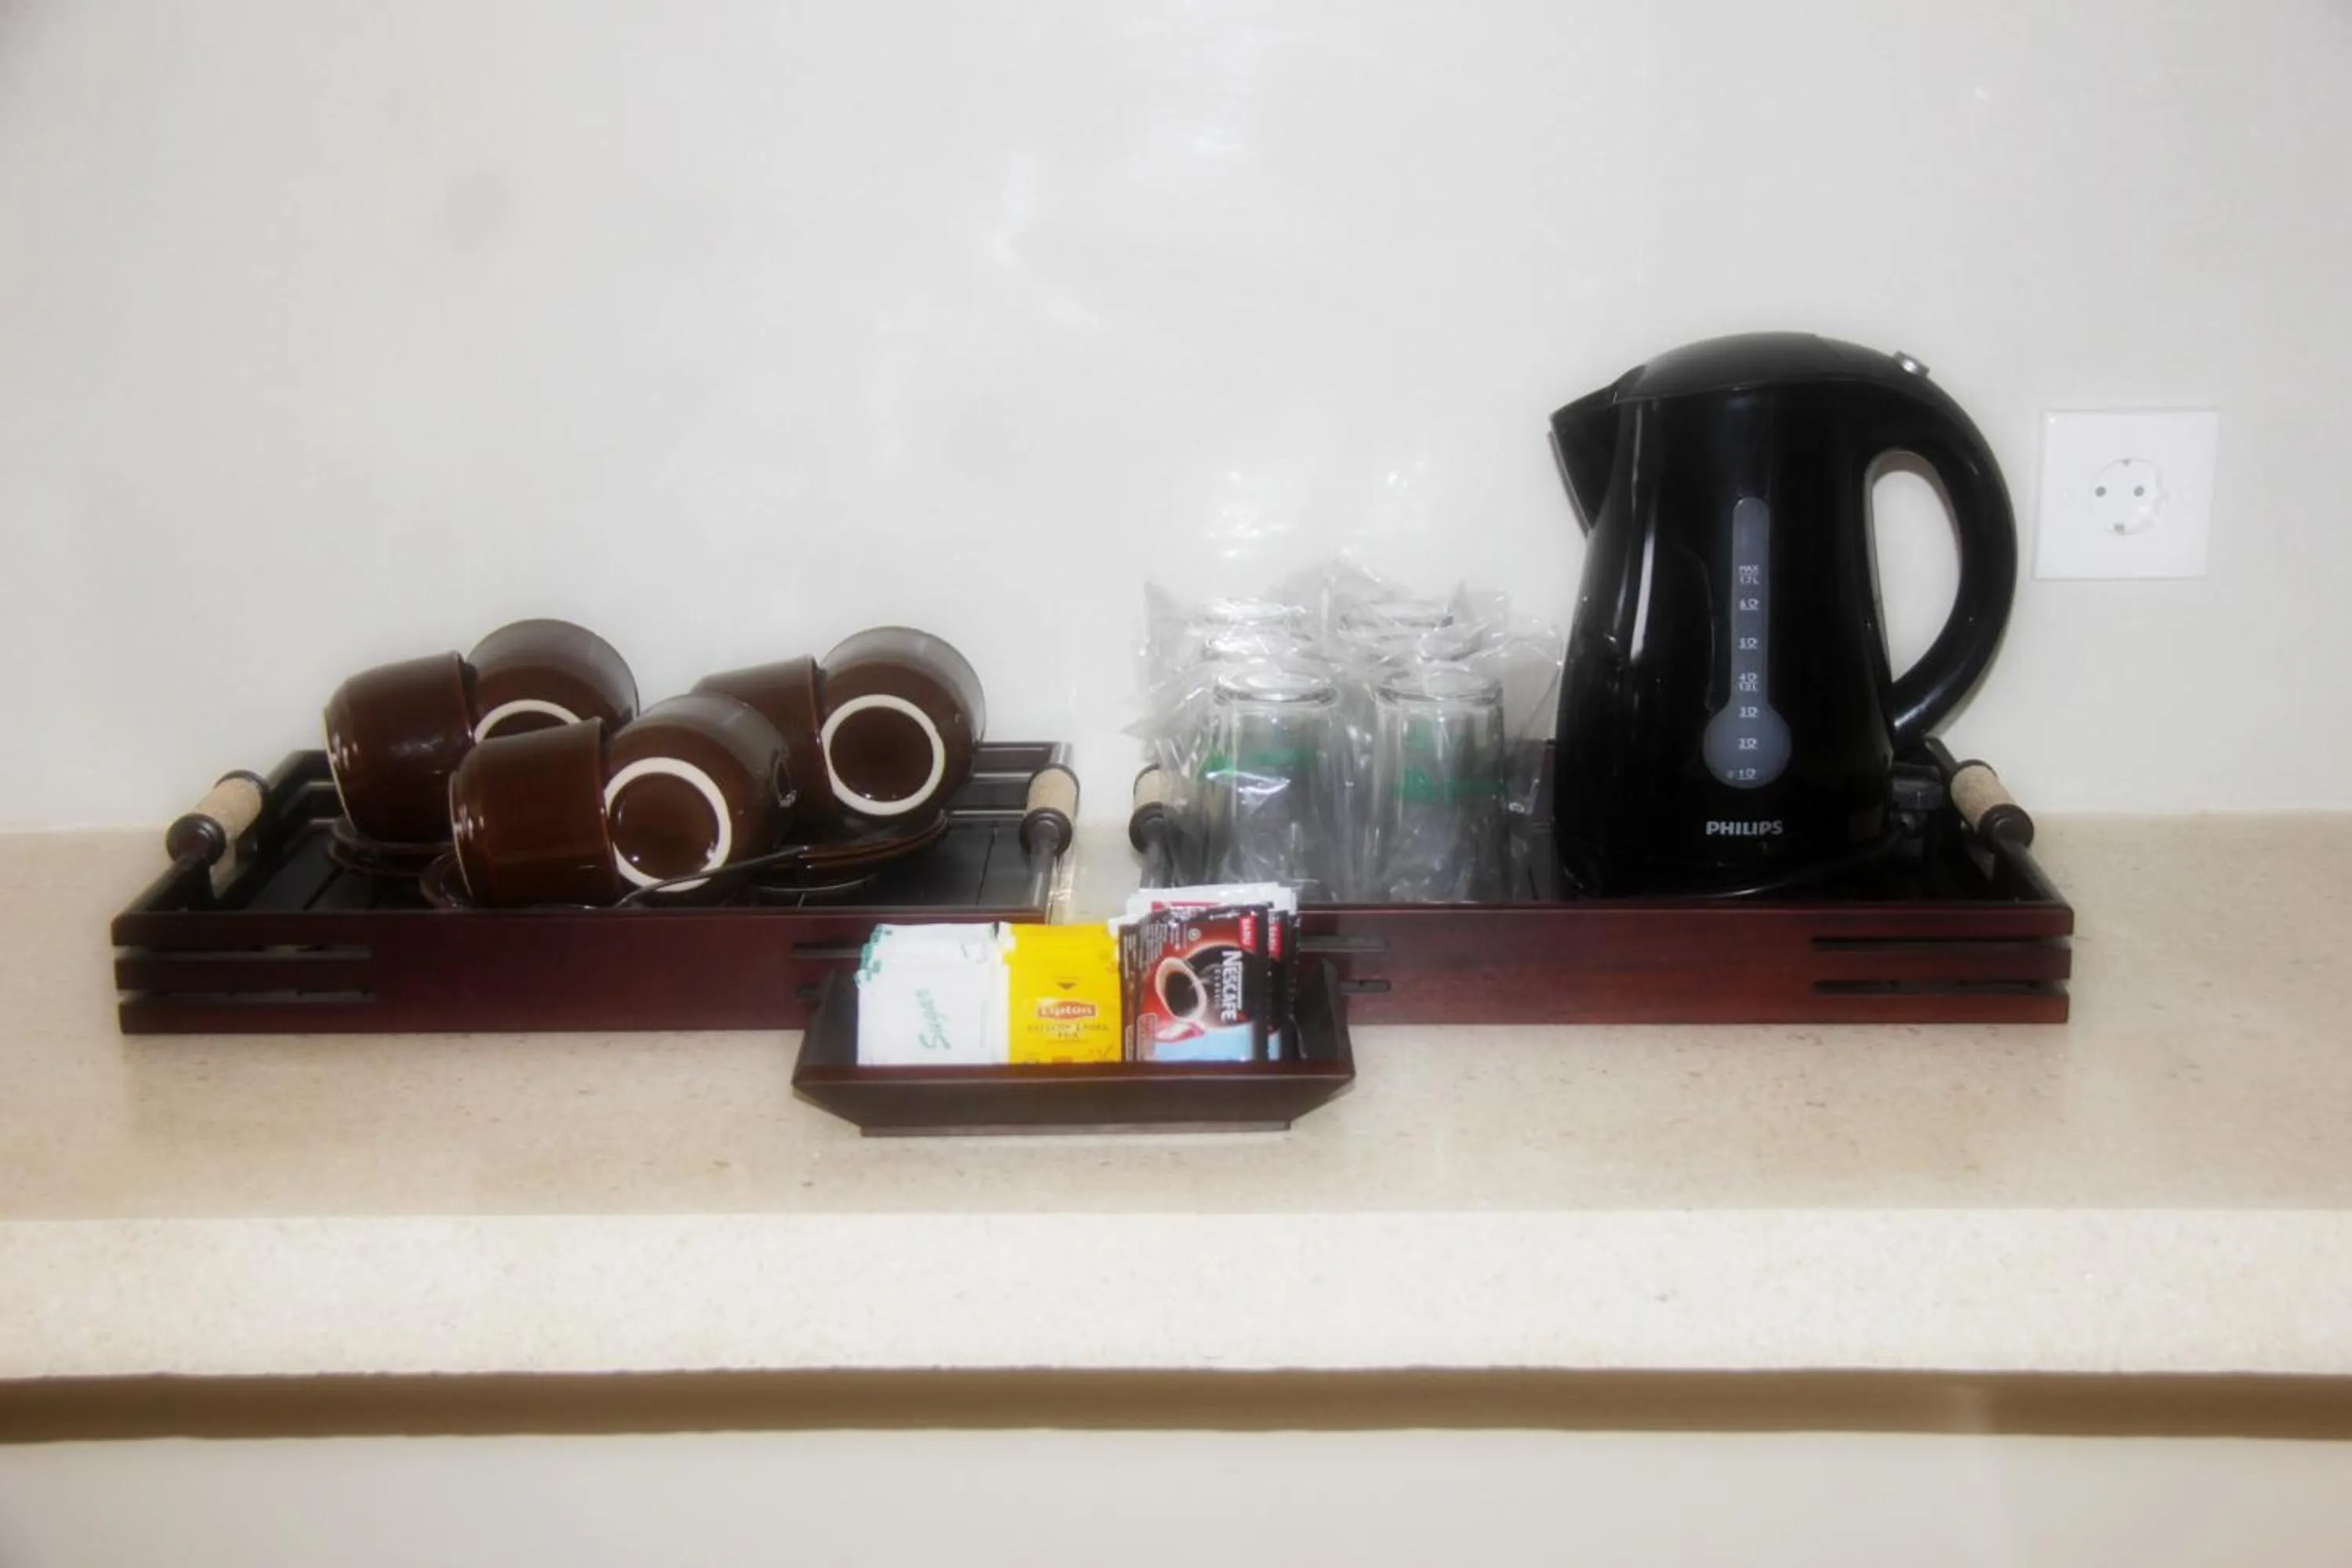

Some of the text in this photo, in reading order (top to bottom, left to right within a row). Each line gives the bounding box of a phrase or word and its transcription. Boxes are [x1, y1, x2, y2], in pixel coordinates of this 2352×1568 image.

[1706, 820, 1782, 835] PHILIPS
[1040, 1005, 1093, 1017] Lipton
[915, 988, 951, 1050] Sugar
